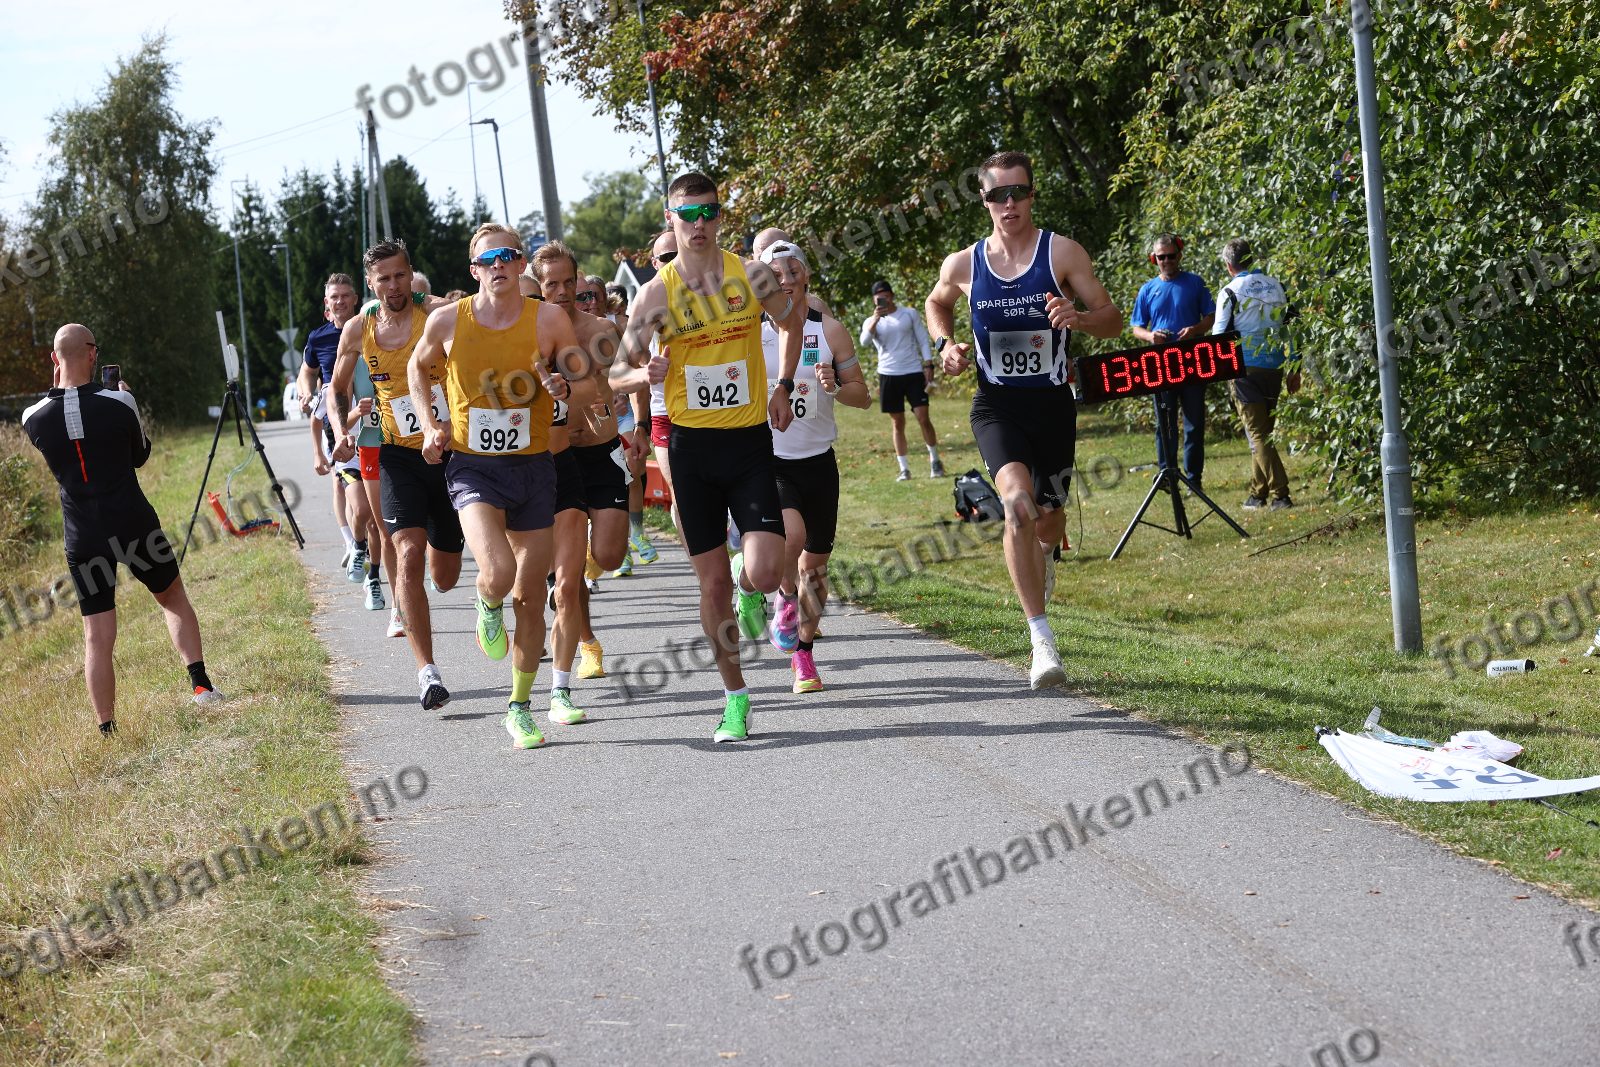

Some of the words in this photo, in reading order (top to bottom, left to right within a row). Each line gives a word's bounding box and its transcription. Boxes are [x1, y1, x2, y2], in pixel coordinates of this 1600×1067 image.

[1004, 308, 1025, 317] SØR
[1002, 352, 1041, 374] 993
[1101, 341, 1238, 393] 13:00:04
[698, 383, 739, 407] 942
[789, 398, 806, 418] 6
[480, 429, 519, 451] 992
